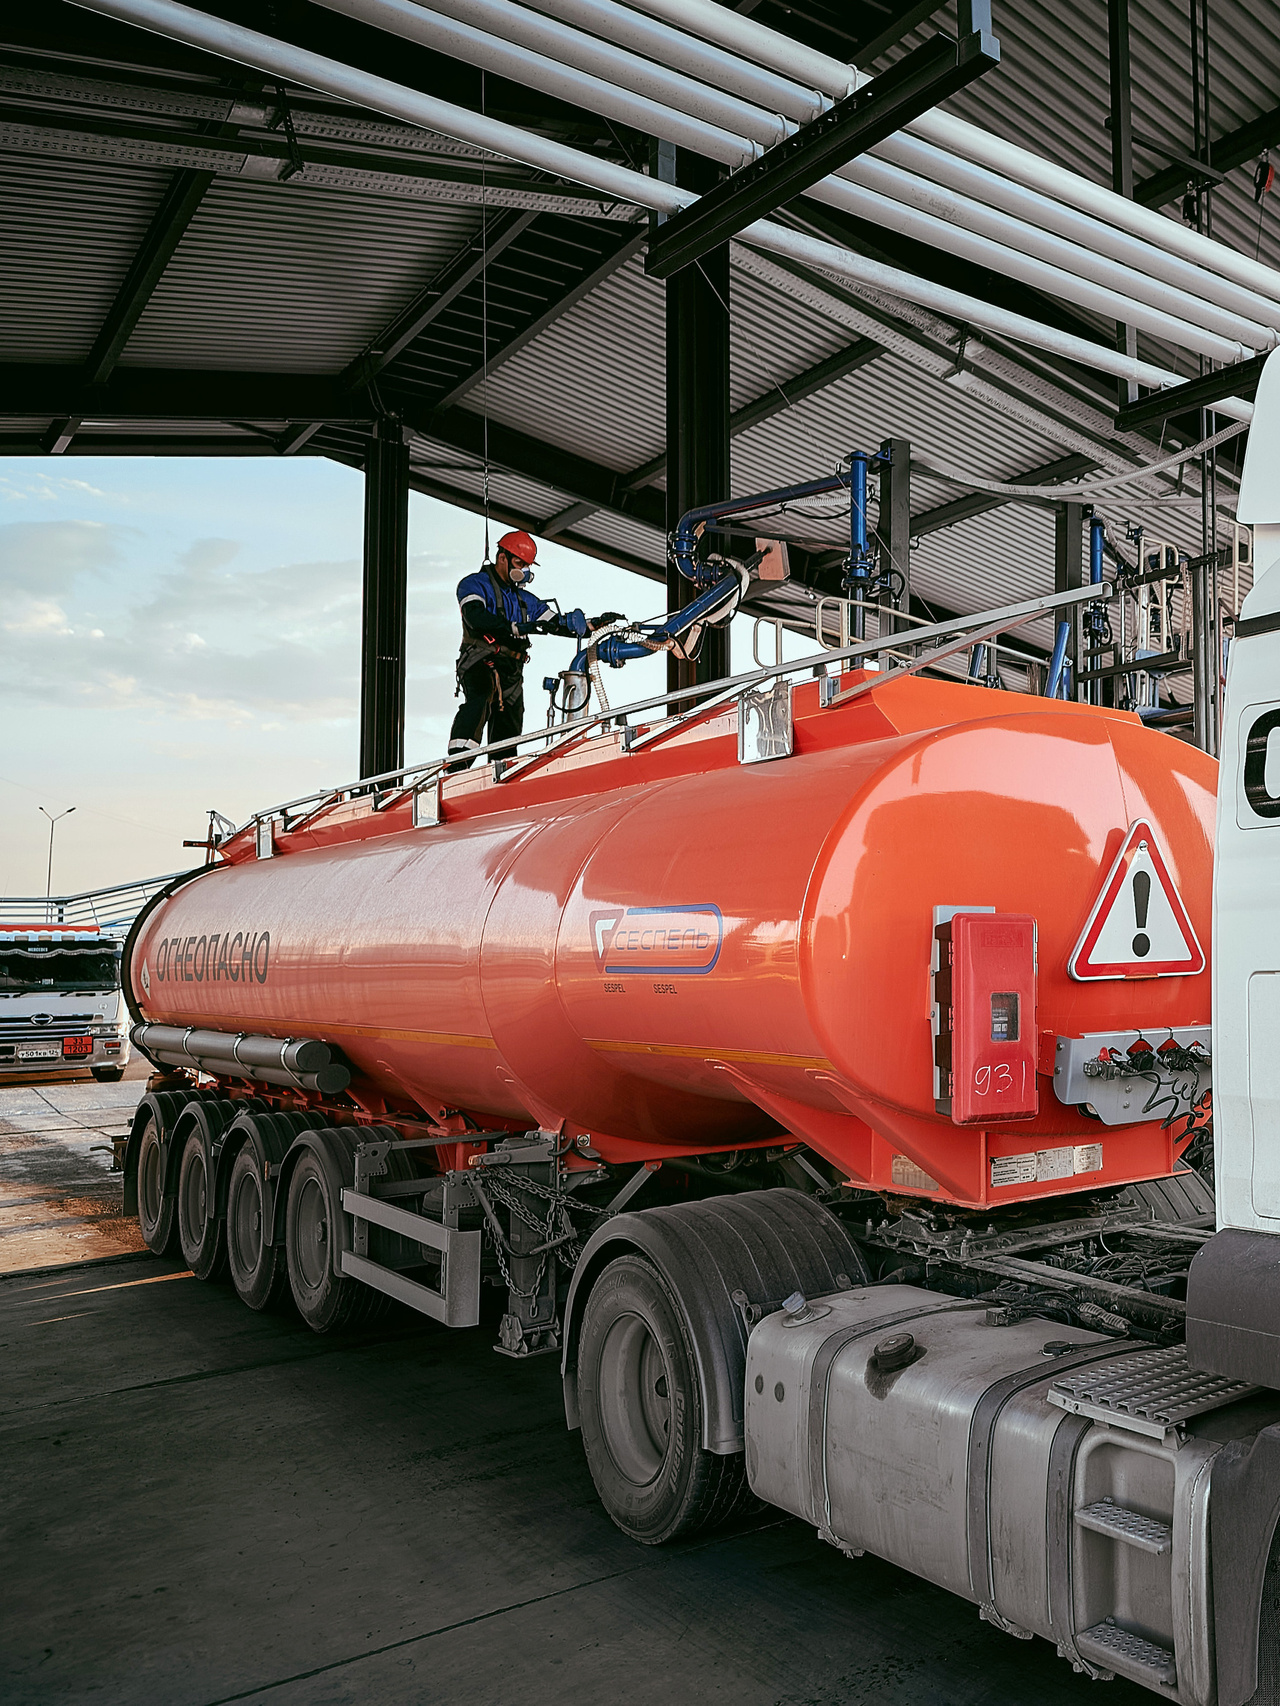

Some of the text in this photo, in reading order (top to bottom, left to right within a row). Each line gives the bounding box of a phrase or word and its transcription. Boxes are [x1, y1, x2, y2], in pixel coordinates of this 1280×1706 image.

[614, 928, 710, 950] СЕСПЕЛЬ
[157, 931, 270, 984] ОГНЕОПАСНО
[604, 983, 626, 993] SESPEL
[653, 984, 677, 994] SESPEL
